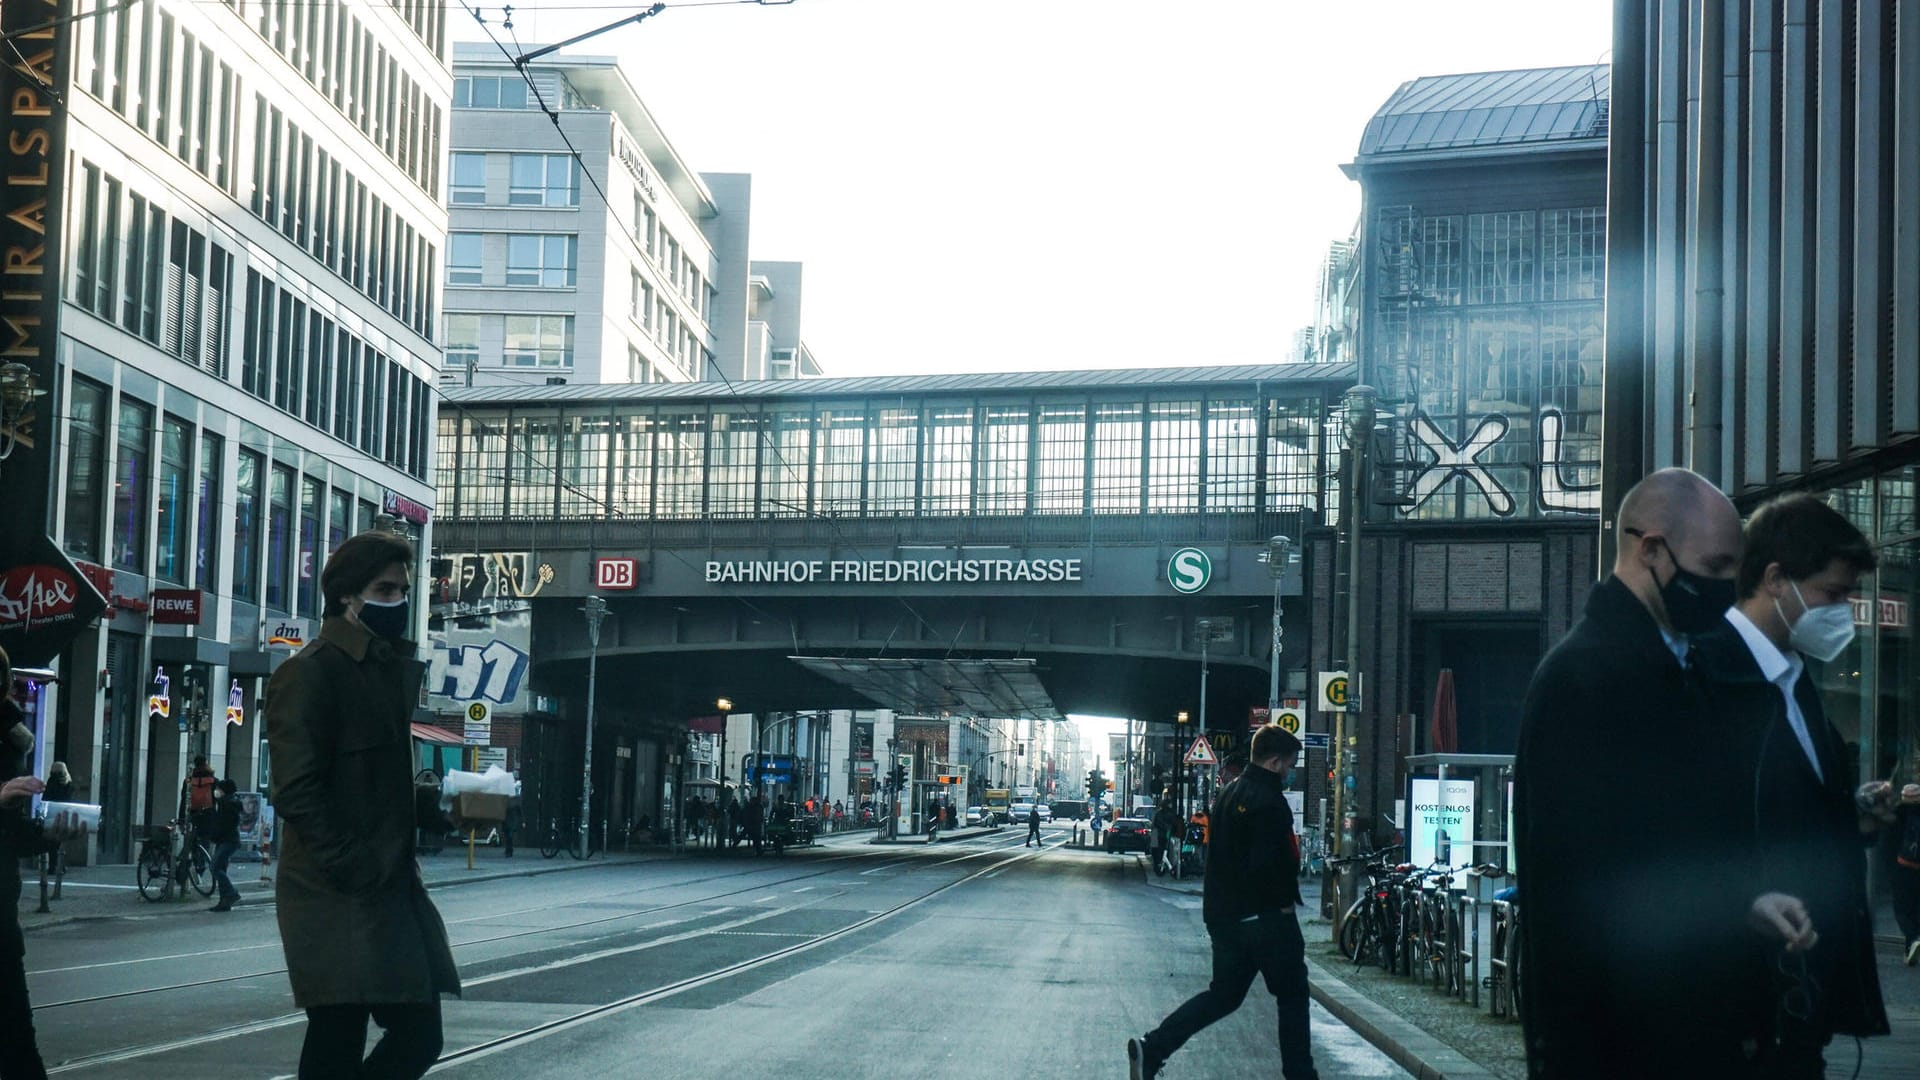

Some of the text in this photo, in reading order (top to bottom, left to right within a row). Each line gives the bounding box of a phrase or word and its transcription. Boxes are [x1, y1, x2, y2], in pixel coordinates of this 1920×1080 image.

[602, 563, 629, 584] DB
[705, 558, 1081, 583] BAHNHOF FRIEDRICHSTRASSE
[1175, 551, 1204, 590] S
[156, 599, 194, 610] REWE
[275, 623, 300, 637] dm
[1415, 804, 1471, 812] KOSTENLOS
